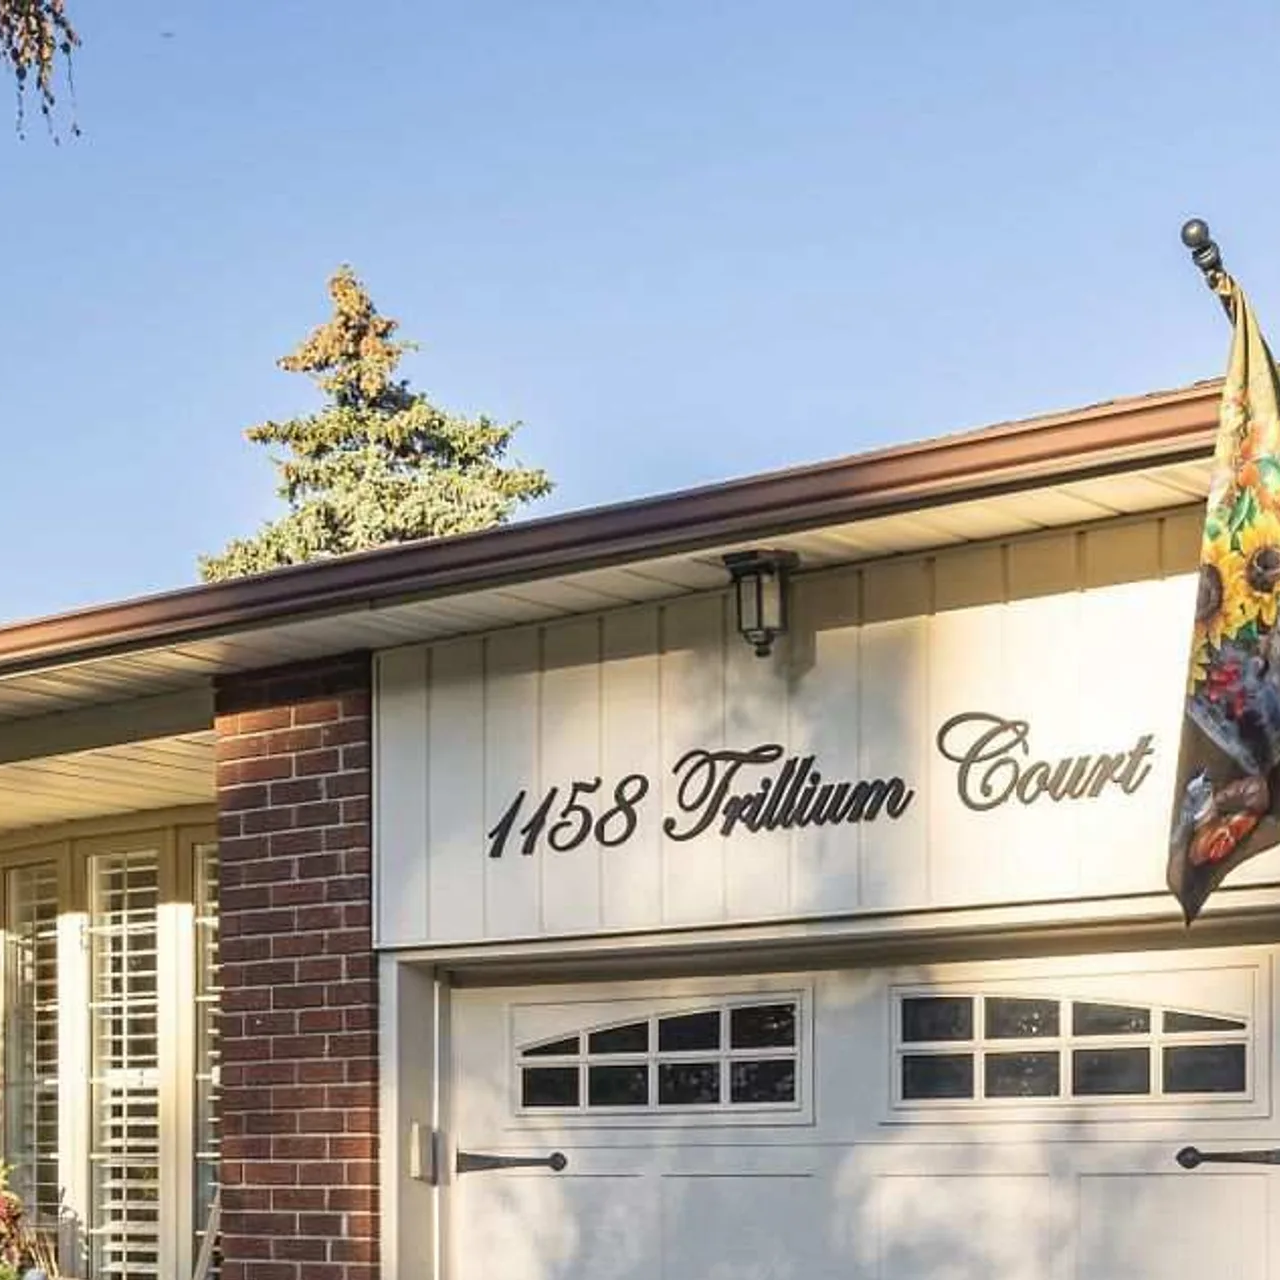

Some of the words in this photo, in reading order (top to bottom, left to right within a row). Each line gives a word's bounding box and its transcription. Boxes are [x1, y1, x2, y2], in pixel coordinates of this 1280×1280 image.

[489, 776, 649, 858] 1158
[663, 744, 914, 841] Trillium
[936, 711, 1156, 812] Court
